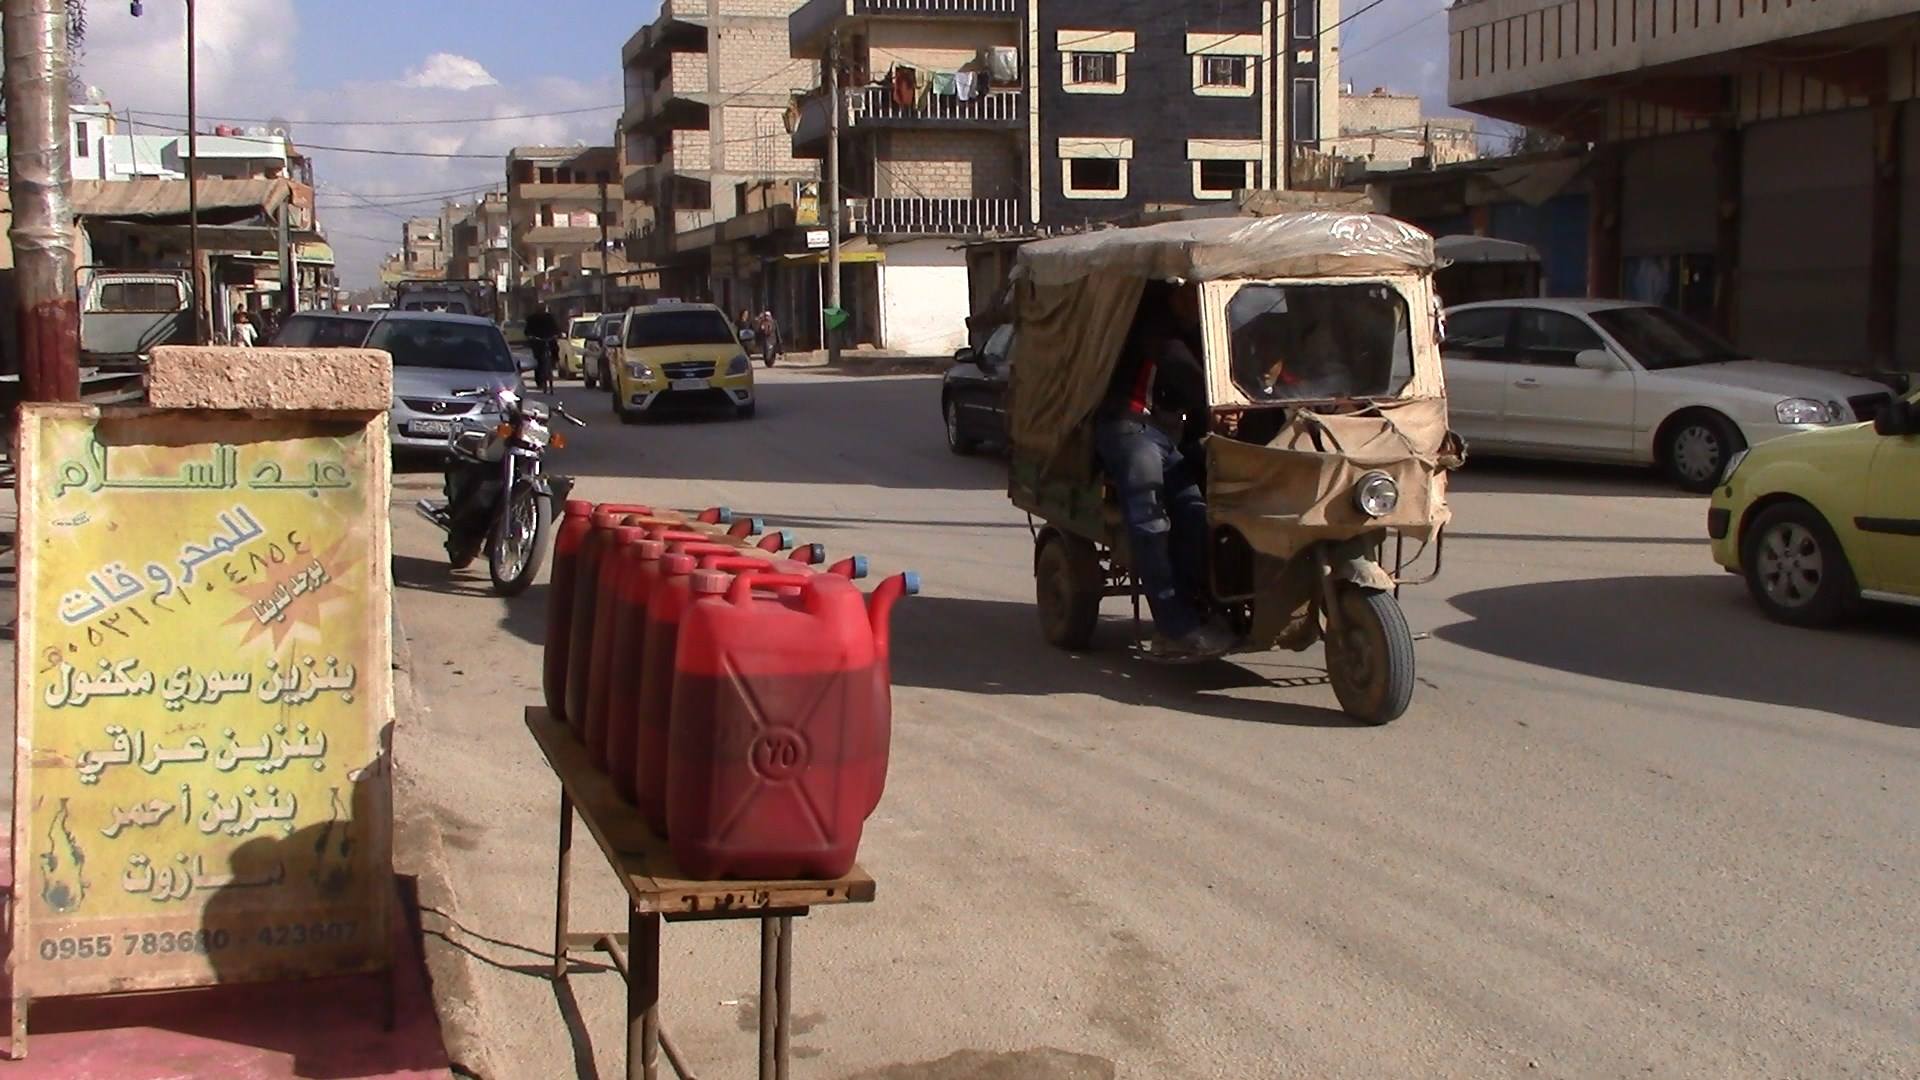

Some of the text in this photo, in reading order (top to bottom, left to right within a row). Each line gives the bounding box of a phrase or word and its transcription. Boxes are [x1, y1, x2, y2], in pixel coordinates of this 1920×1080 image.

[54, 425, 351, 498] عبد السلام
[60, 506, 263, 622] للمحروقات
[251, 559, 332, 625] يوجد لدينا
[44, 655, 356, 711] بنزين سوري مكفول
[77, 723, 327, 784] بنزين عراقي
[101, 783, 297, 838] بنزين أحمر
[39, 937, 113, 961] 0955
